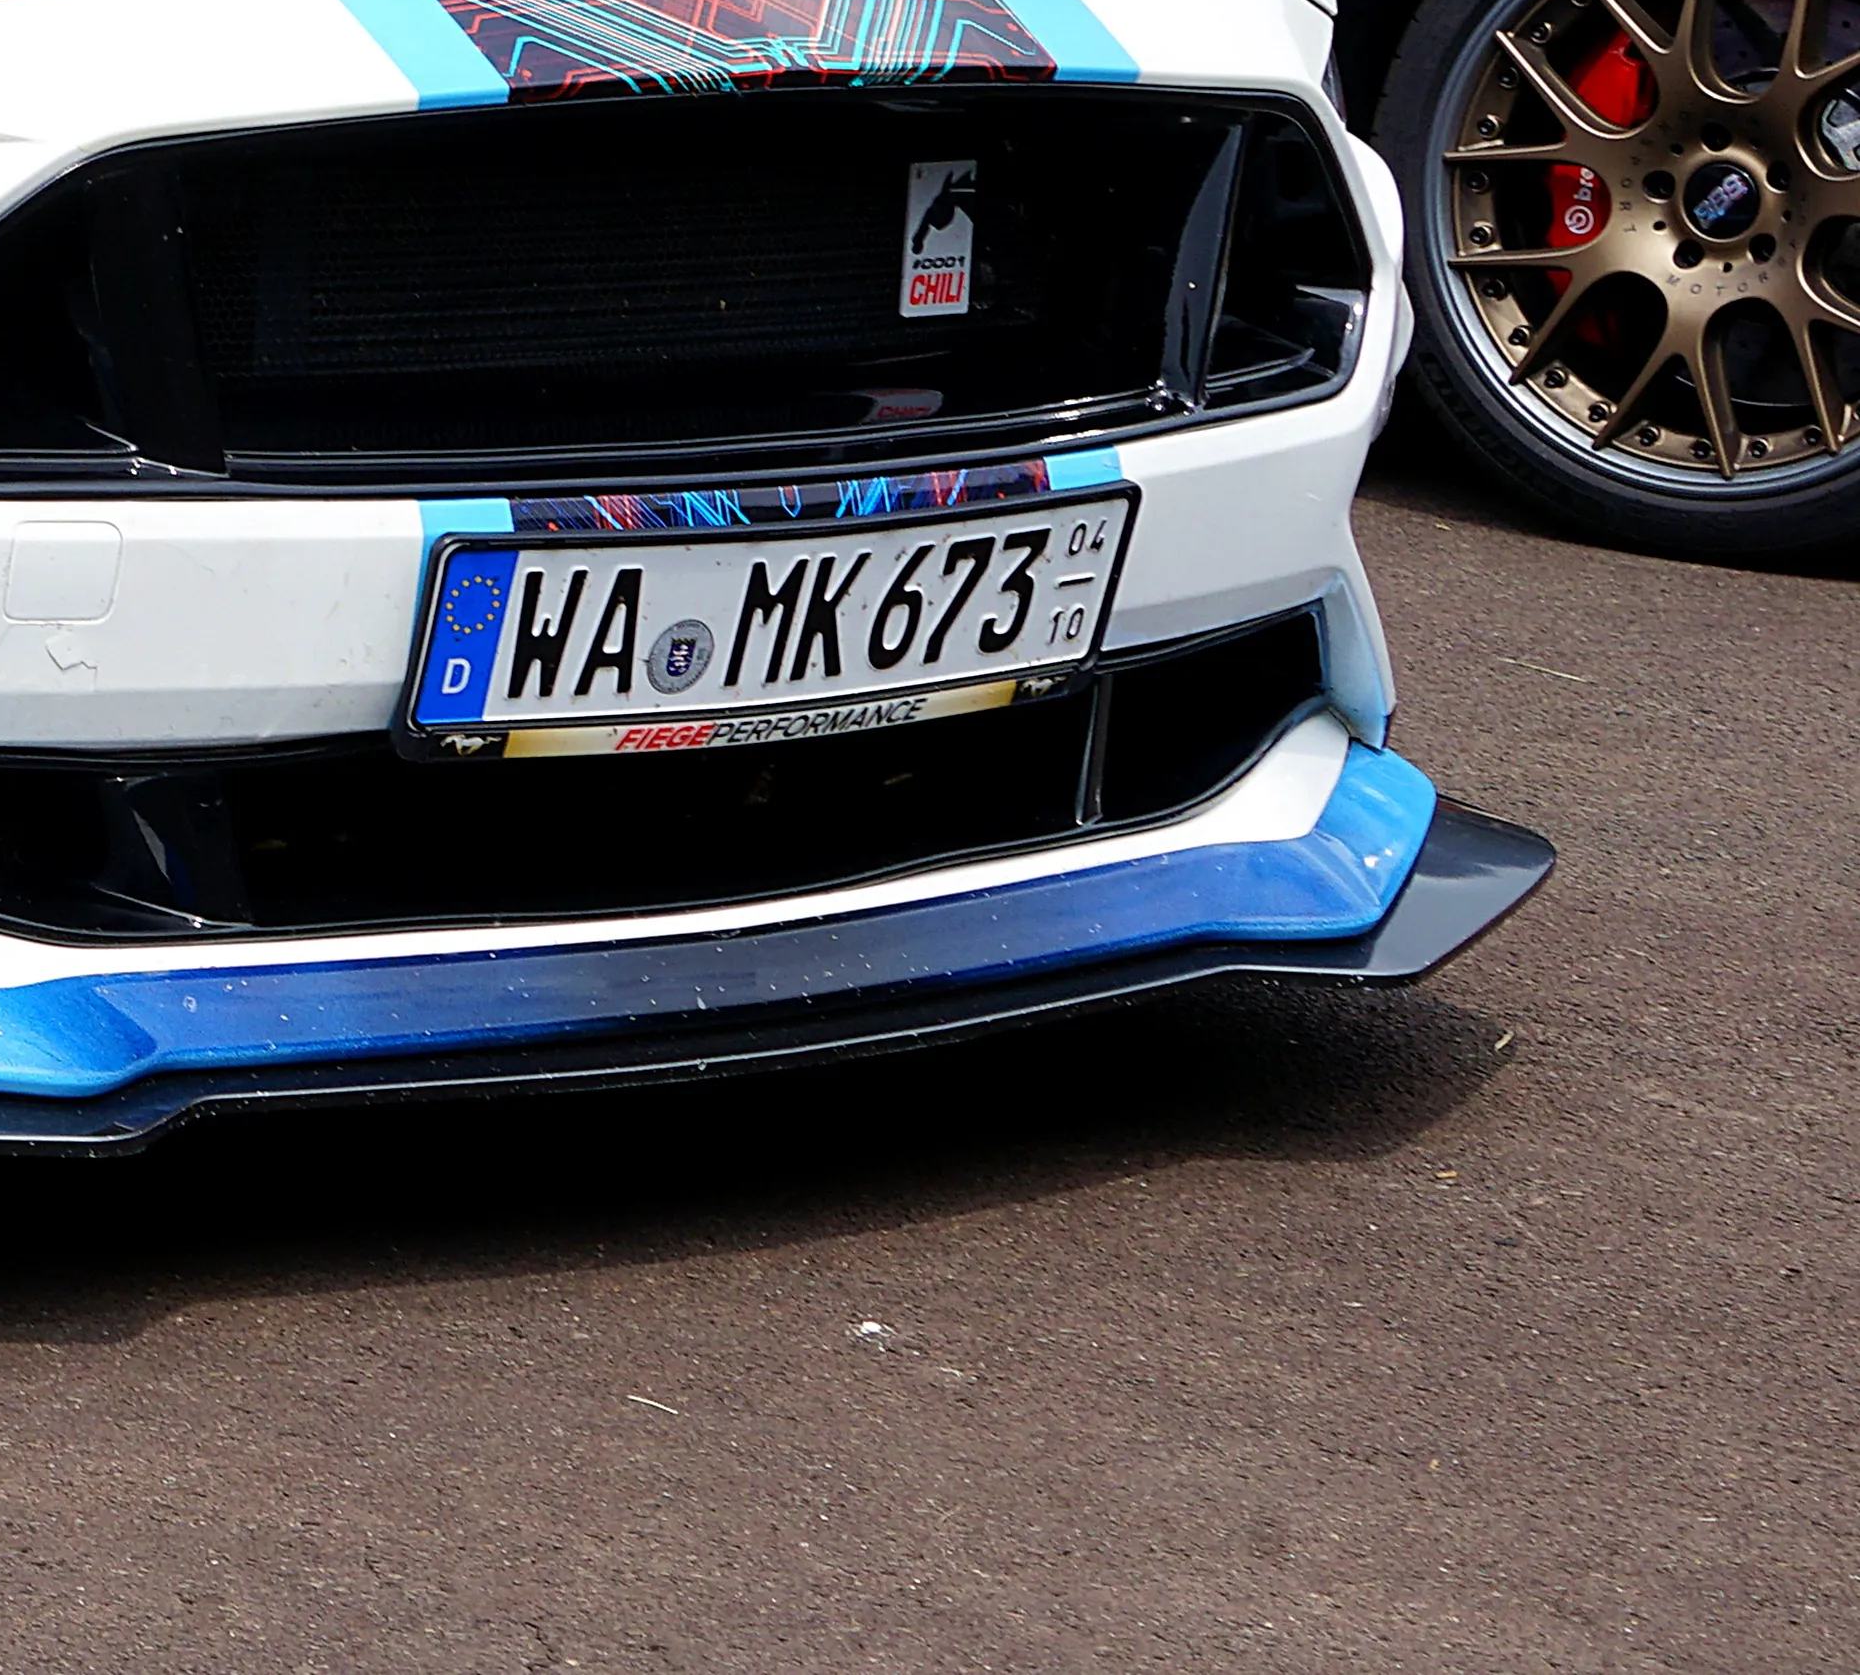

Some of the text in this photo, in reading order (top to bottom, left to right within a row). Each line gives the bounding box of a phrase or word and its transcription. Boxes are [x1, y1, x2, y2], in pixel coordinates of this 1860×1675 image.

[908, 271, 966, 307] CHILI
[1066, 515, 1106, 558] 04
[505, 567, 645, 699] WA
[1047, 605, 1084, 645] 10
[441, 656, 472, 696] D
[614, 697, 923, 753] FIEGEPERFORMANCE
